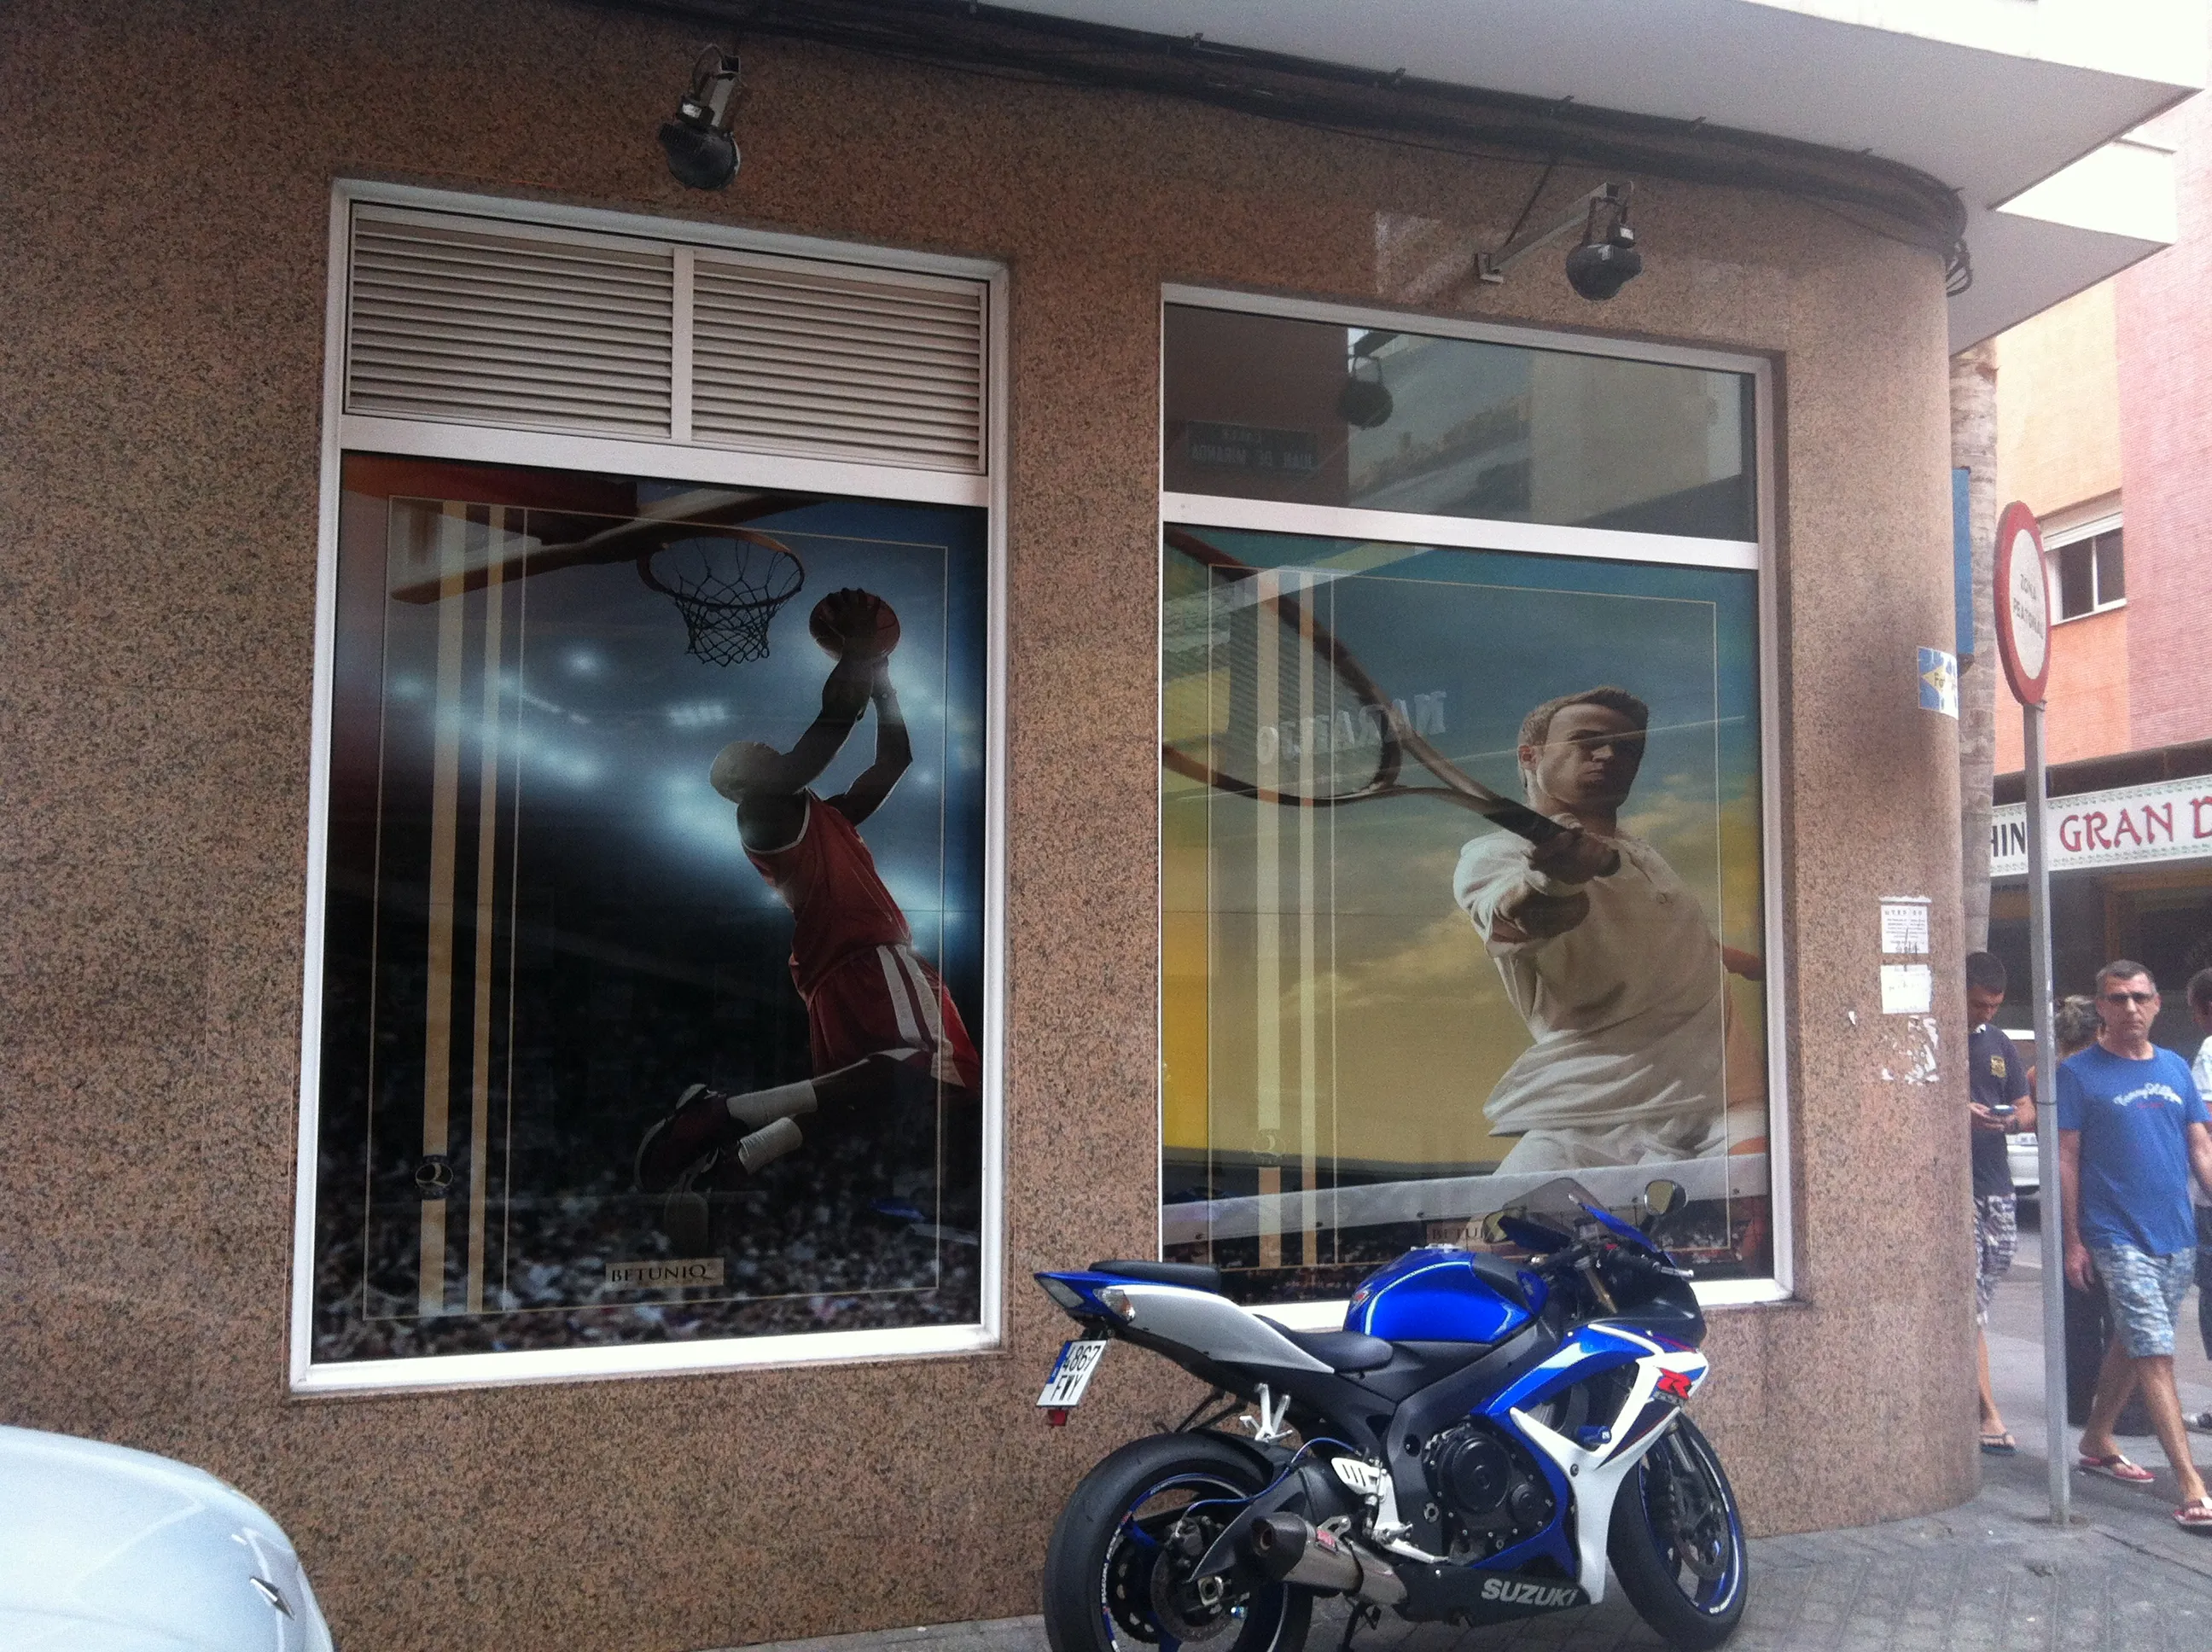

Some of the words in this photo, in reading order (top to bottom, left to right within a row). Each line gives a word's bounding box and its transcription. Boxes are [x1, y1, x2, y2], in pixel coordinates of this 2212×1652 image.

[2059, 801, 2175, 852] GRAN
[611, 1264, 713, 1283] BETUNIQ
[1062, 1345, 1102, 1372] 4867
[1481, 1578, 1580, 1607] SUZUKI
